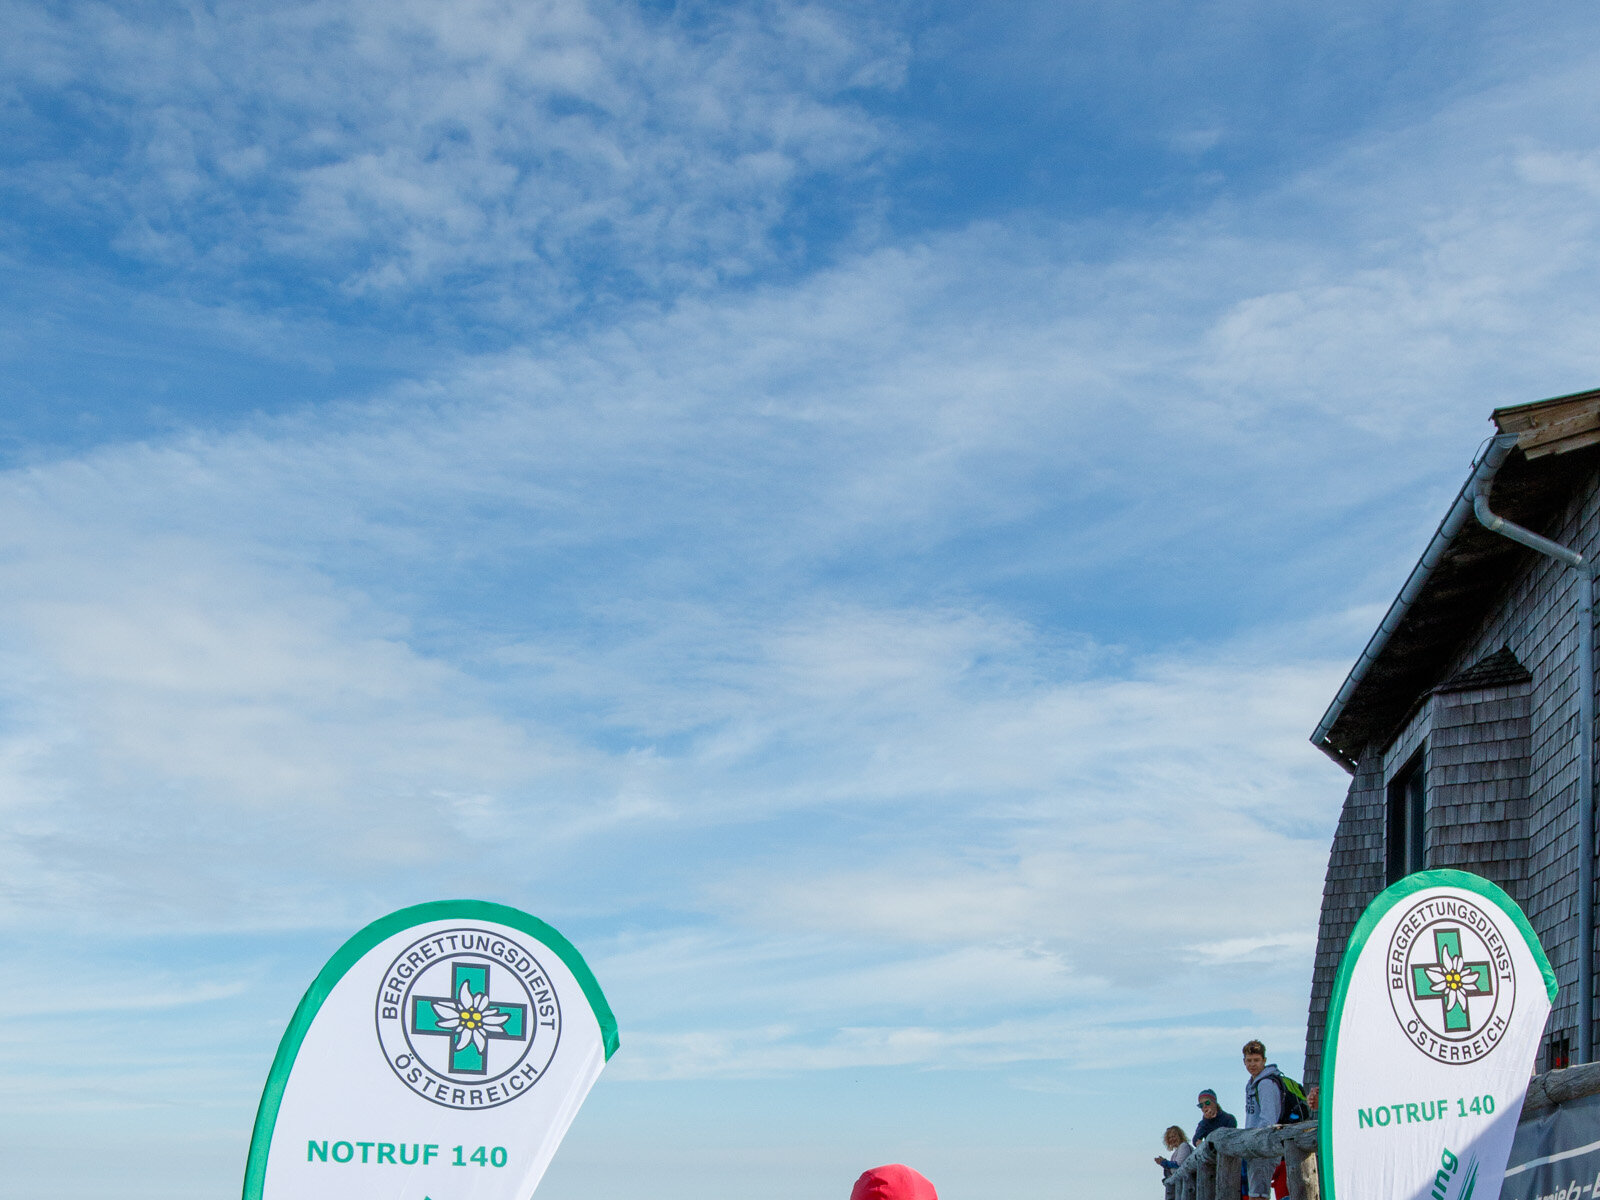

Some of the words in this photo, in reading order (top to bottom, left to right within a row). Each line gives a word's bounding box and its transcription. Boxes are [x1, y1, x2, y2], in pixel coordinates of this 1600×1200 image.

[1392, 901, 1512, 990] BERGRETTUNGSDIENST
[382, 934, 555, 1031] BERGRETTUNGSDIENST
[1407, 1014, 1506, 1061] ÖSTERREICH
[395, 1053, 539, 1106] ÖSTERREICH
[1358, 1099, 1448, 1129] NOTRUF
[1457, 1094, 1496, 1118] 140
[307, 1140, 439, 1165] NOTRUF
[451, 1145, 508, 1168] 140
